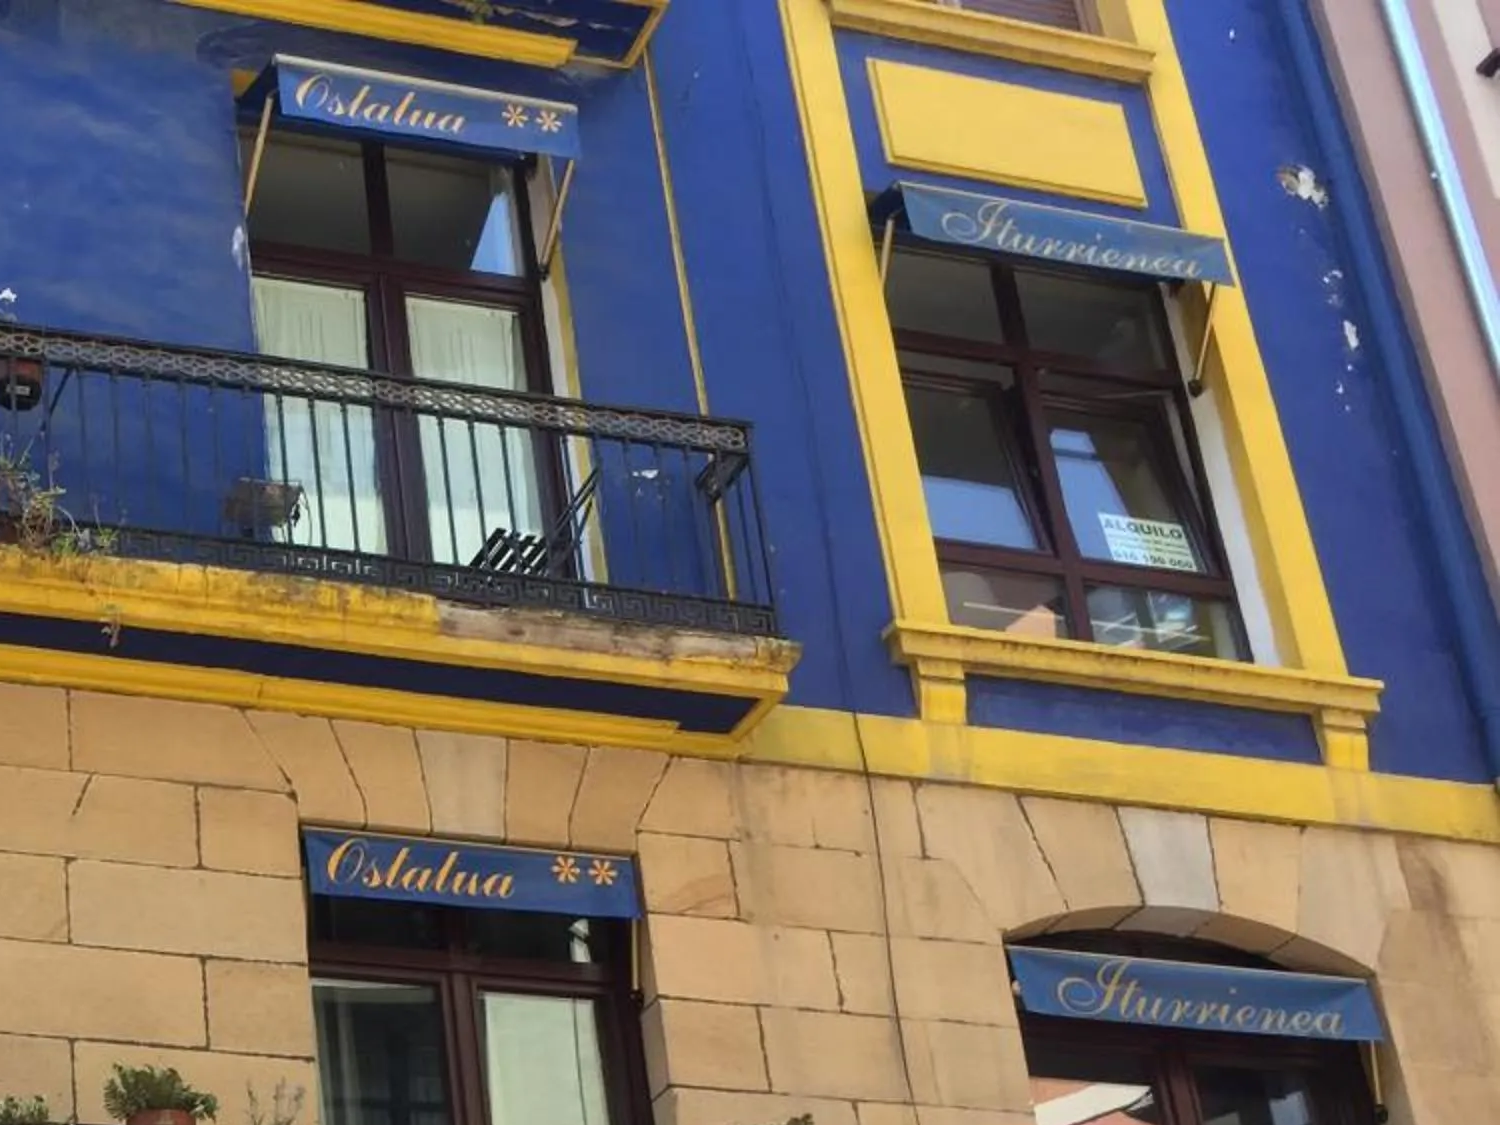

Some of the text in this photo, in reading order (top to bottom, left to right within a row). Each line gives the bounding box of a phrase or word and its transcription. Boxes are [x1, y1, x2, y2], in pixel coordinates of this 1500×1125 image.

[295, 73, 467, 134] Ostatua
[941, 199, 1202, 279] Iturrienea
[1104, 518, 1183, 540] ALQUILO
[326, 838, 517, 899] Ostatua
[1056, 957, 1346, 1036] Iturrienea
